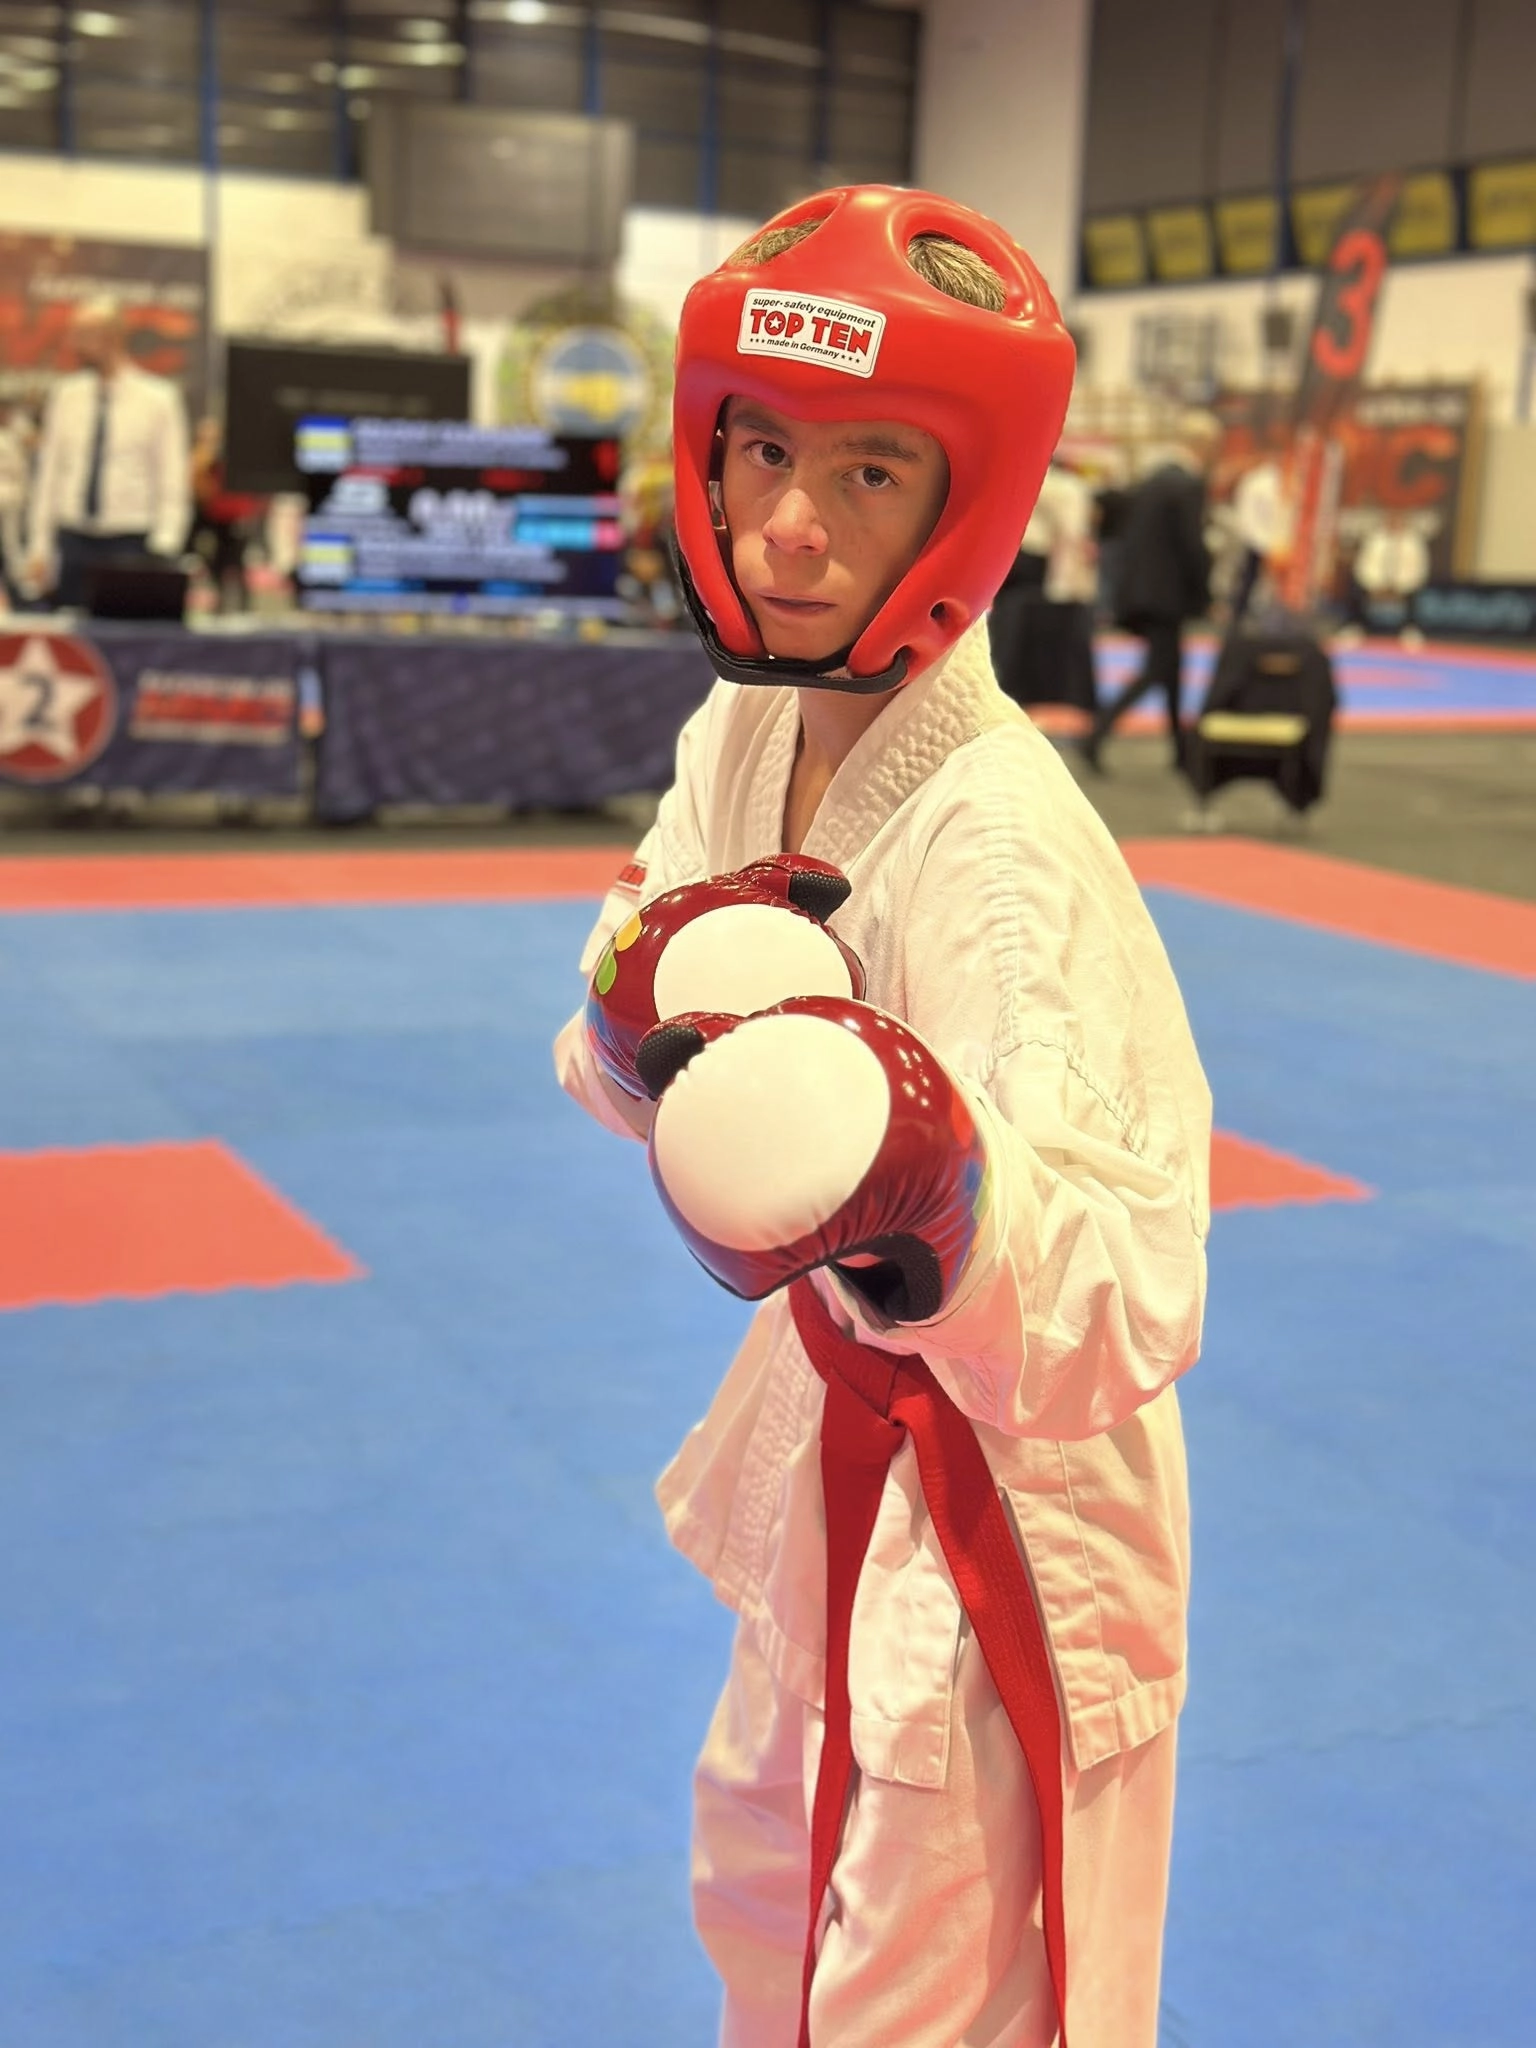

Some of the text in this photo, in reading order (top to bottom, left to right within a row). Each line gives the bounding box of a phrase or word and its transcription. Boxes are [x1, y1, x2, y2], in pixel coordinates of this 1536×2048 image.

[817, 306, 876, 328] equipment
[1312, 229, 1388, 379] 3
[750, 309, 872, 357] TOP TEN
[766, 338, 840, 359] made in Germany
[19, 673, 54, 728] 2
